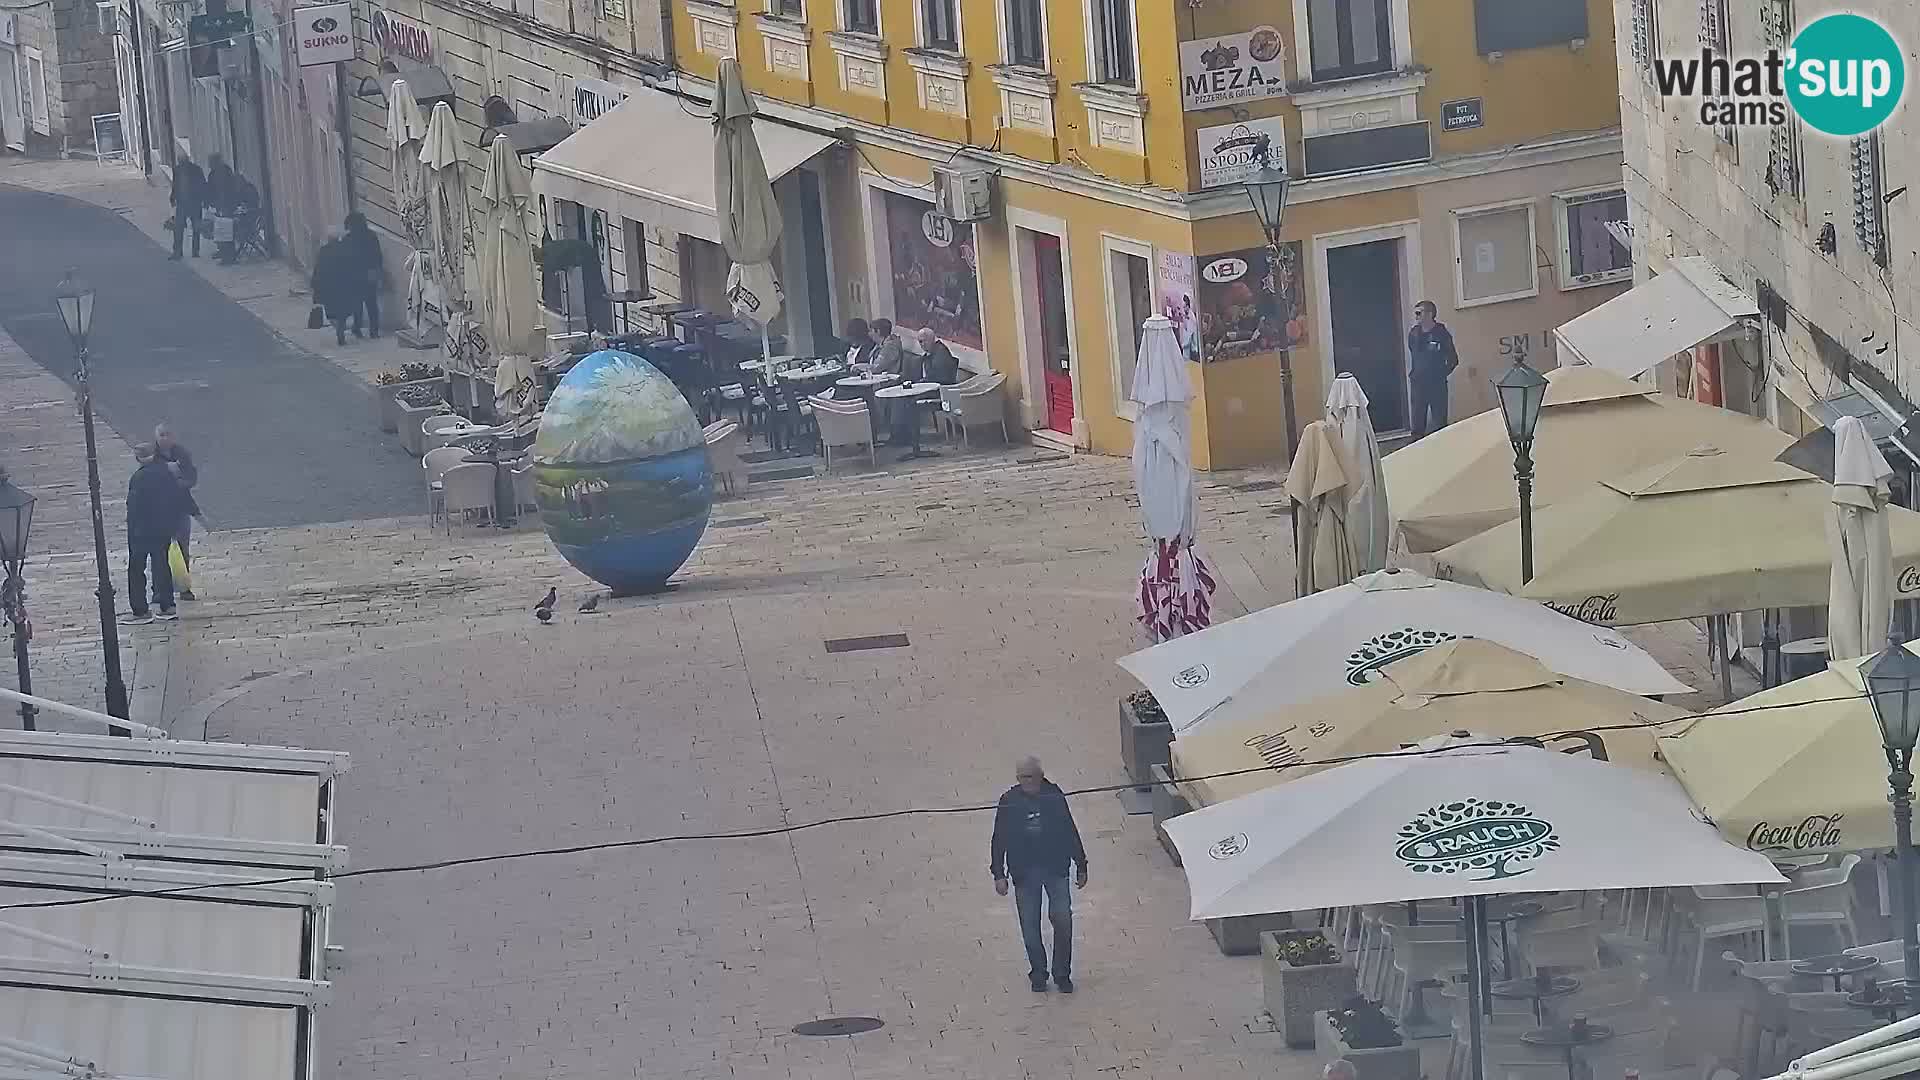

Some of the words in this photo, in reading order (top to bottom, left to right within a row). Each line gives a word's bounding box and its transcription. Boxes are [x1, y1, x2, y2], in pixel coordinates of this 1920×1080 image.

[304, 34, 349, 49] SUKNO
[390, 19, 430, 58] SUKNO
[1186, 66, 1265, 97] MEZA
[1195, 92, 1228, 104] PIZZERIA
[1235, 88, 1257, 98] GRILL
[1203, 151, 1250, 170] ISPOD
[1543, 591, 1620, 621] ca-Cola
[1435, 822, 1536, 854] RAUCH
[1746, 812, 1845, 853] Coca-Cola
